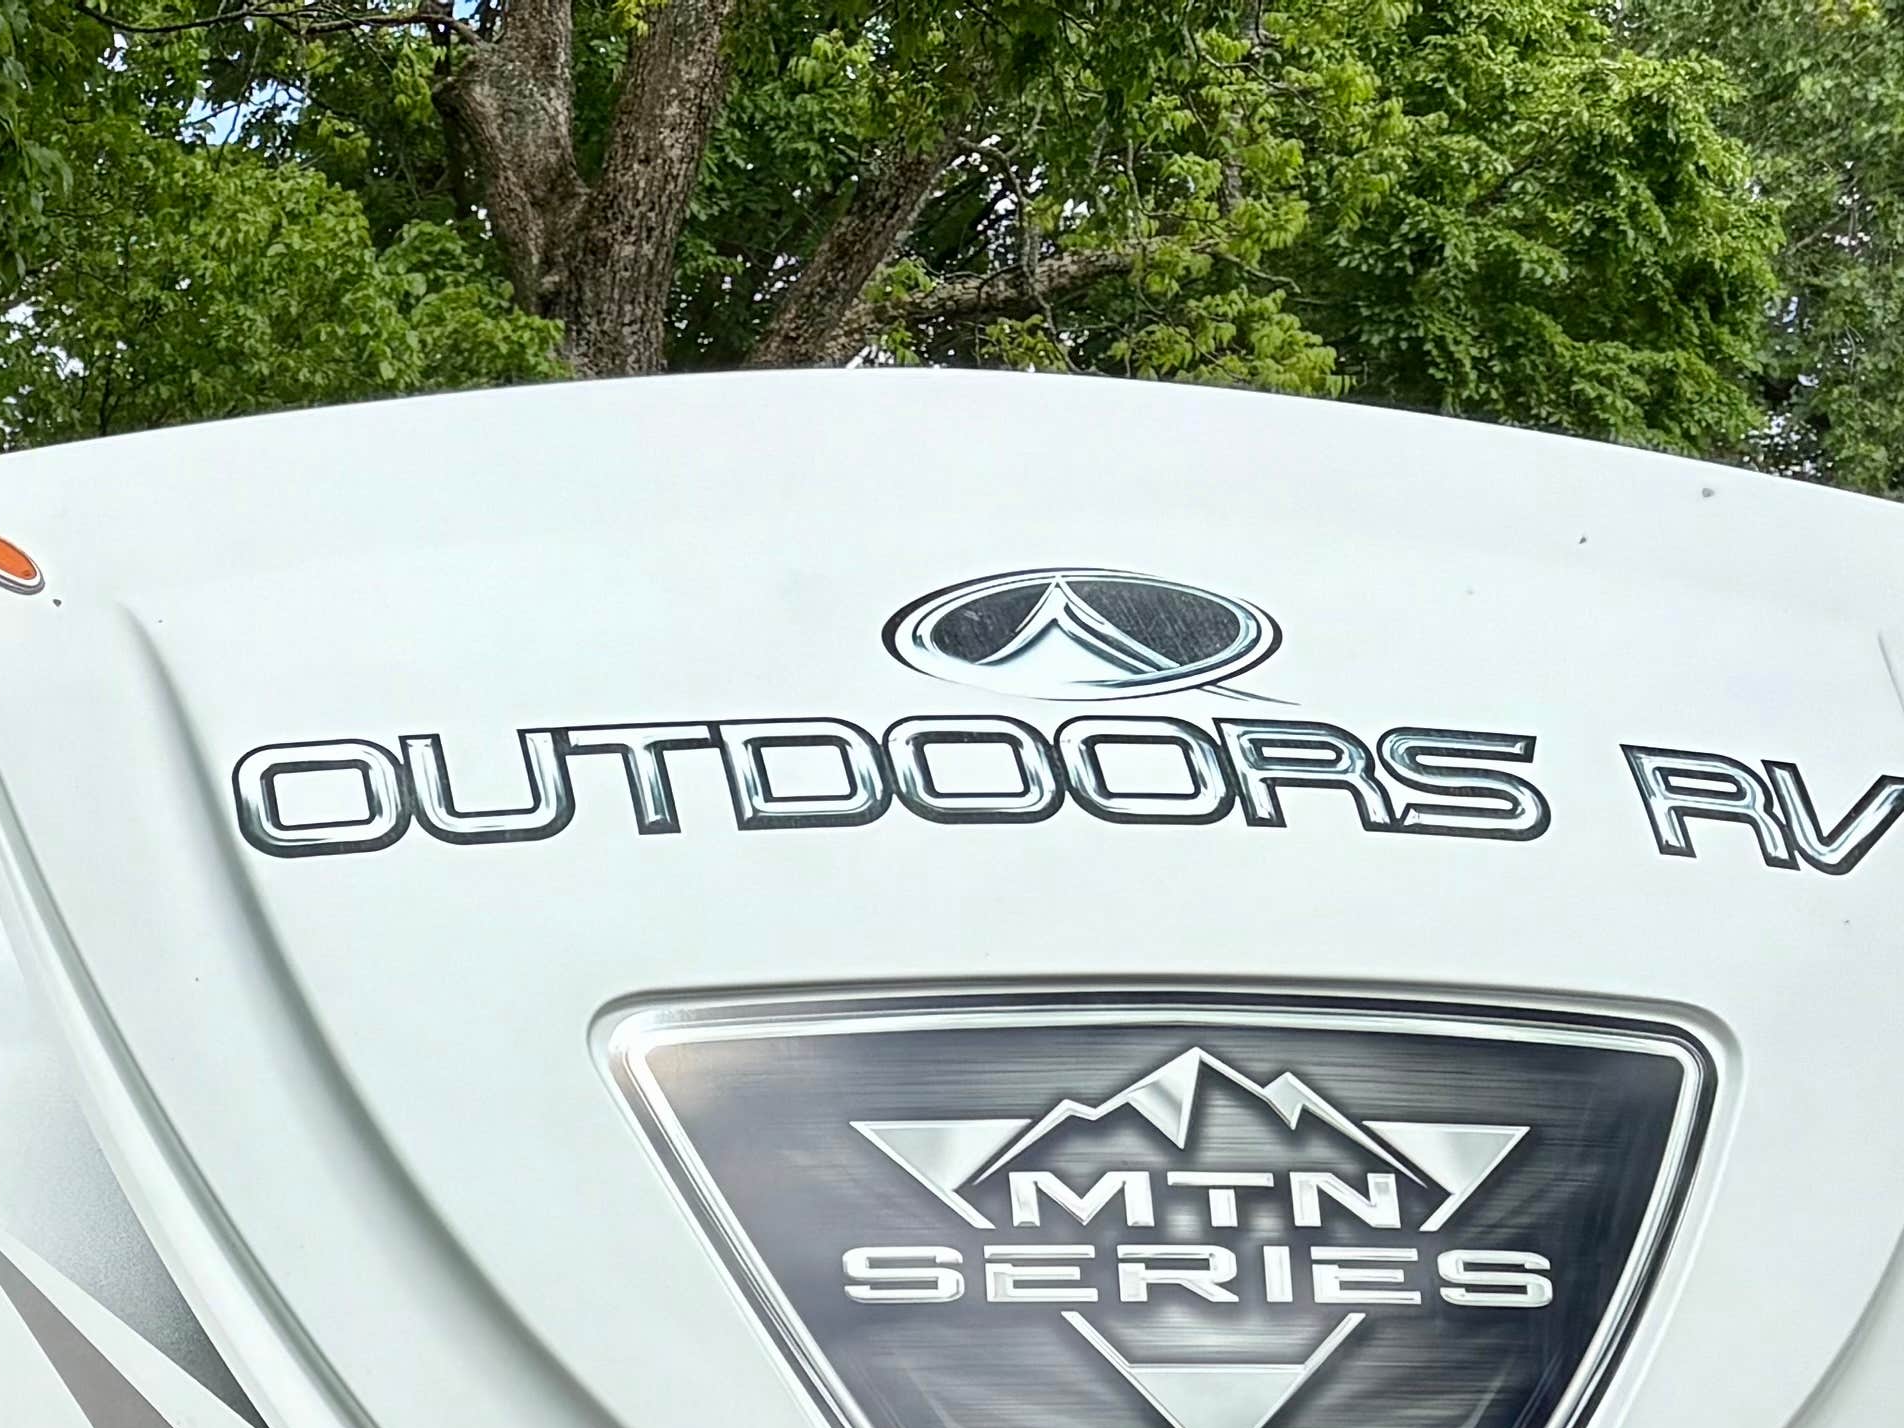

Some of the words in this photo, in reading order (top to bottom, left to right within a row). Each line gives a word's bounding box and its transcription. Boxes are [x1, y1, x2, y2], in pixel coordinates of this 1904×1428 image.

[232, 714, 1551, 858] OUTDOORS
[1619, 743, 1904, 875] RV
[1008, 1171, 1401, 1229] MTN
[842, 1244, 1552, 1307] SERIES
